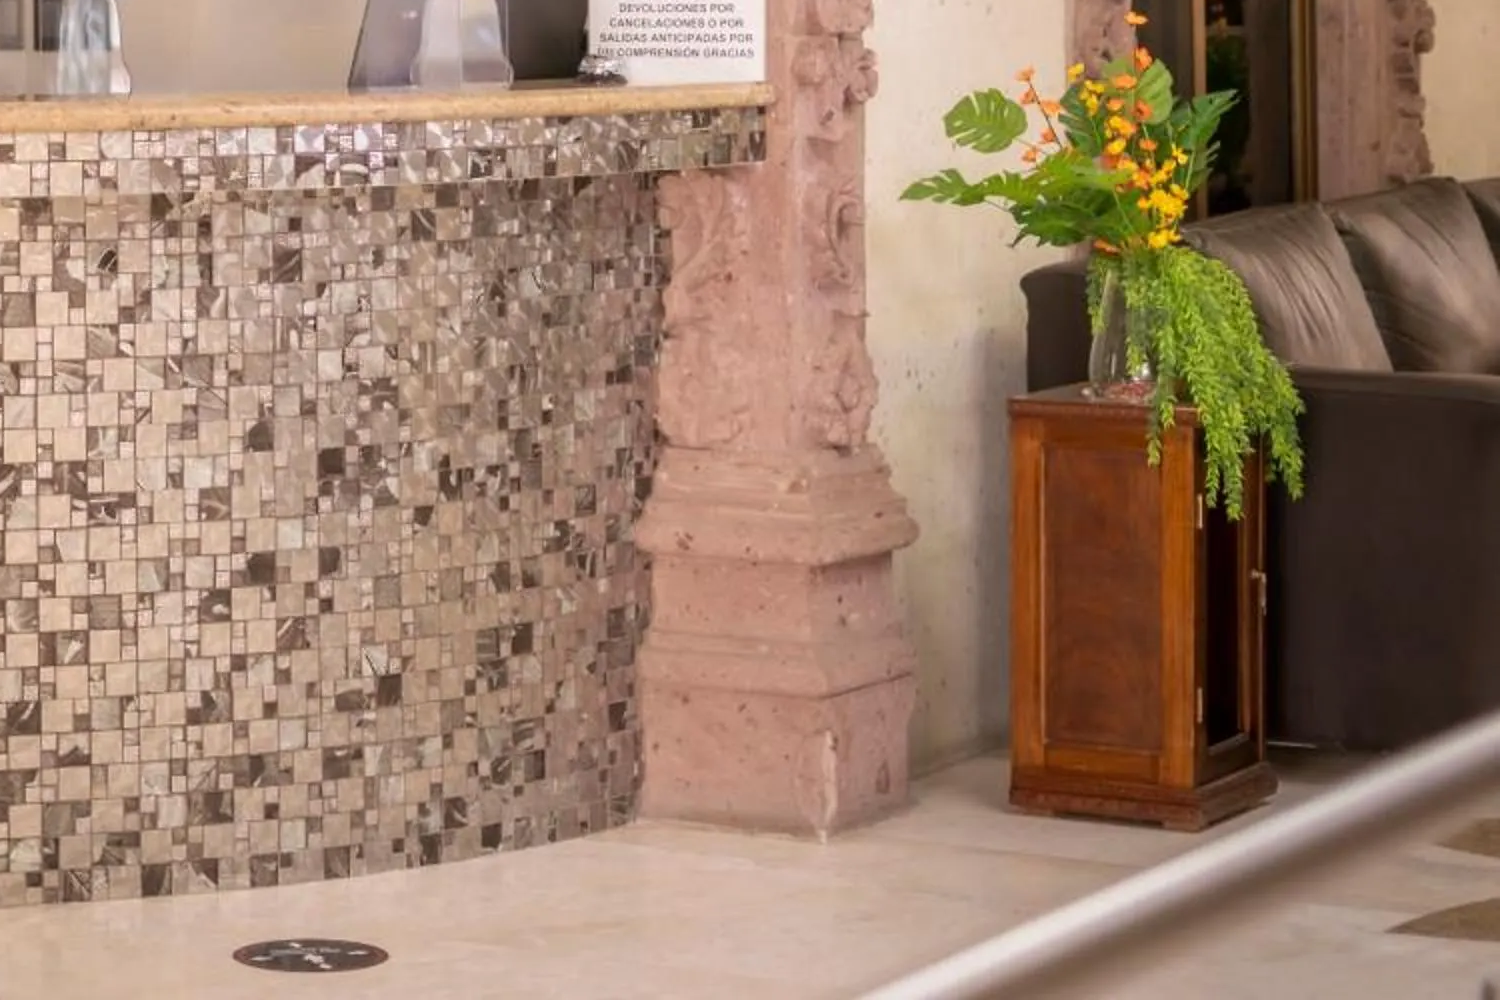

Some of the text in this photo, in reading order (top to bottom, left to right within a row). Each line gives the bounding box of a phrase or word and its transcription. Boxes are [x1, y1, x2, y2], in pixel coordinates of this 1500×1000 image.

[619, 3, 736, 13] DEVOLUCIONES POR
[609, 18, 744, 28] CANCELACIONES O POR
[599, 33, 754, 43] SALIDAS ANTICIPADAS POR
[616, 45, 699, 57] COMPRENSIÓN
[703, 47, 755, 57] GRACIAS
